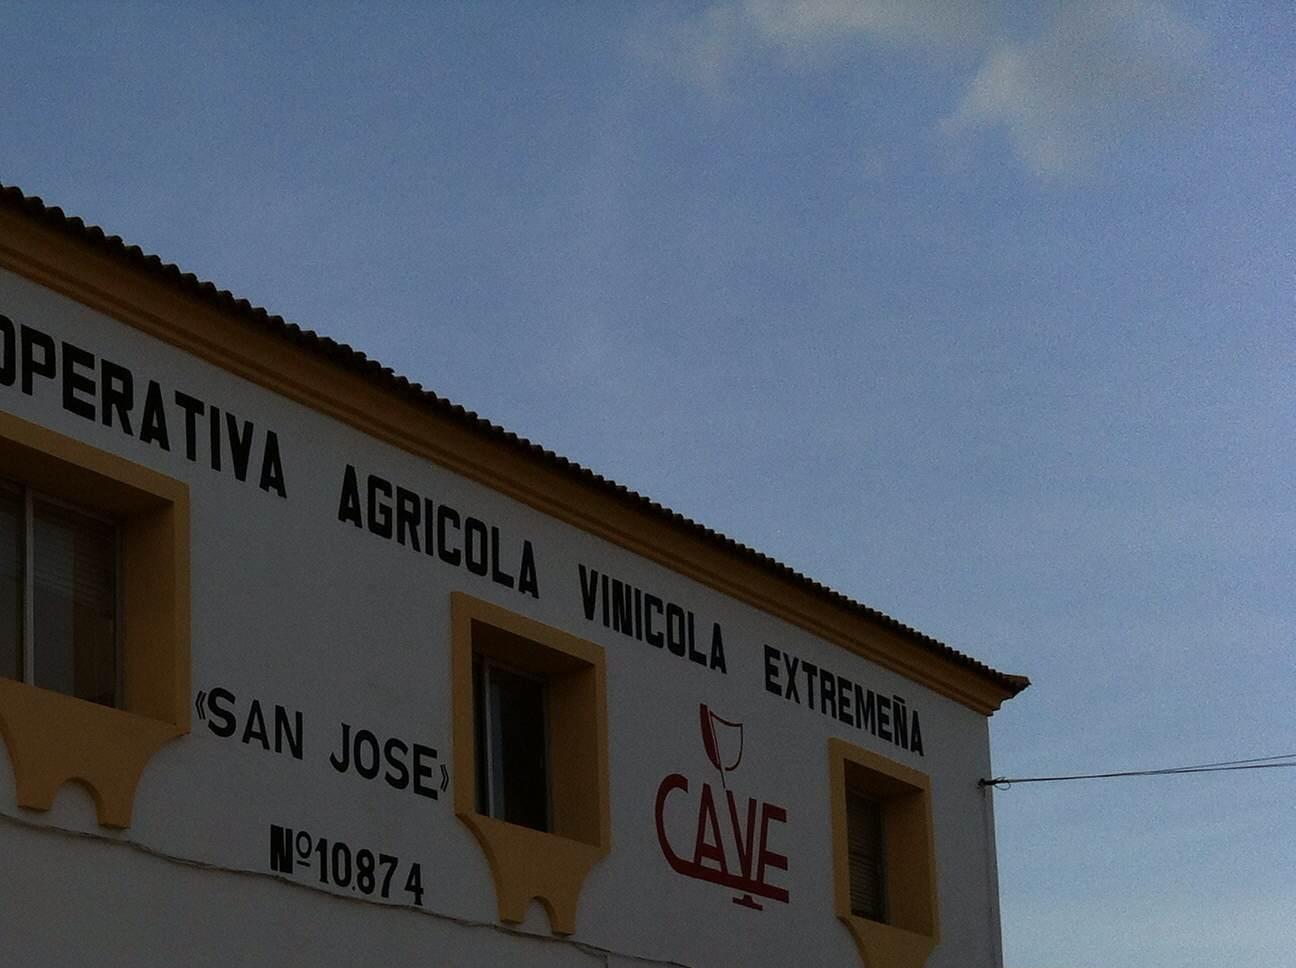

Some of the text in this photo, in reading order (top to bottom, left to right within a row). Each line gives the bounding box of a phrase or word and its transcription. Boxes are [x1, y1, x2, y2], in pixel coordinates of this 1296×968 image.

[337, 463, 540, 600] AGRICOLA
[577, 563, 728, 675] VINICOLA
[763, 643, 925, 757] EXTREMEÑA
[654, 773, 790, 904] CAVE
